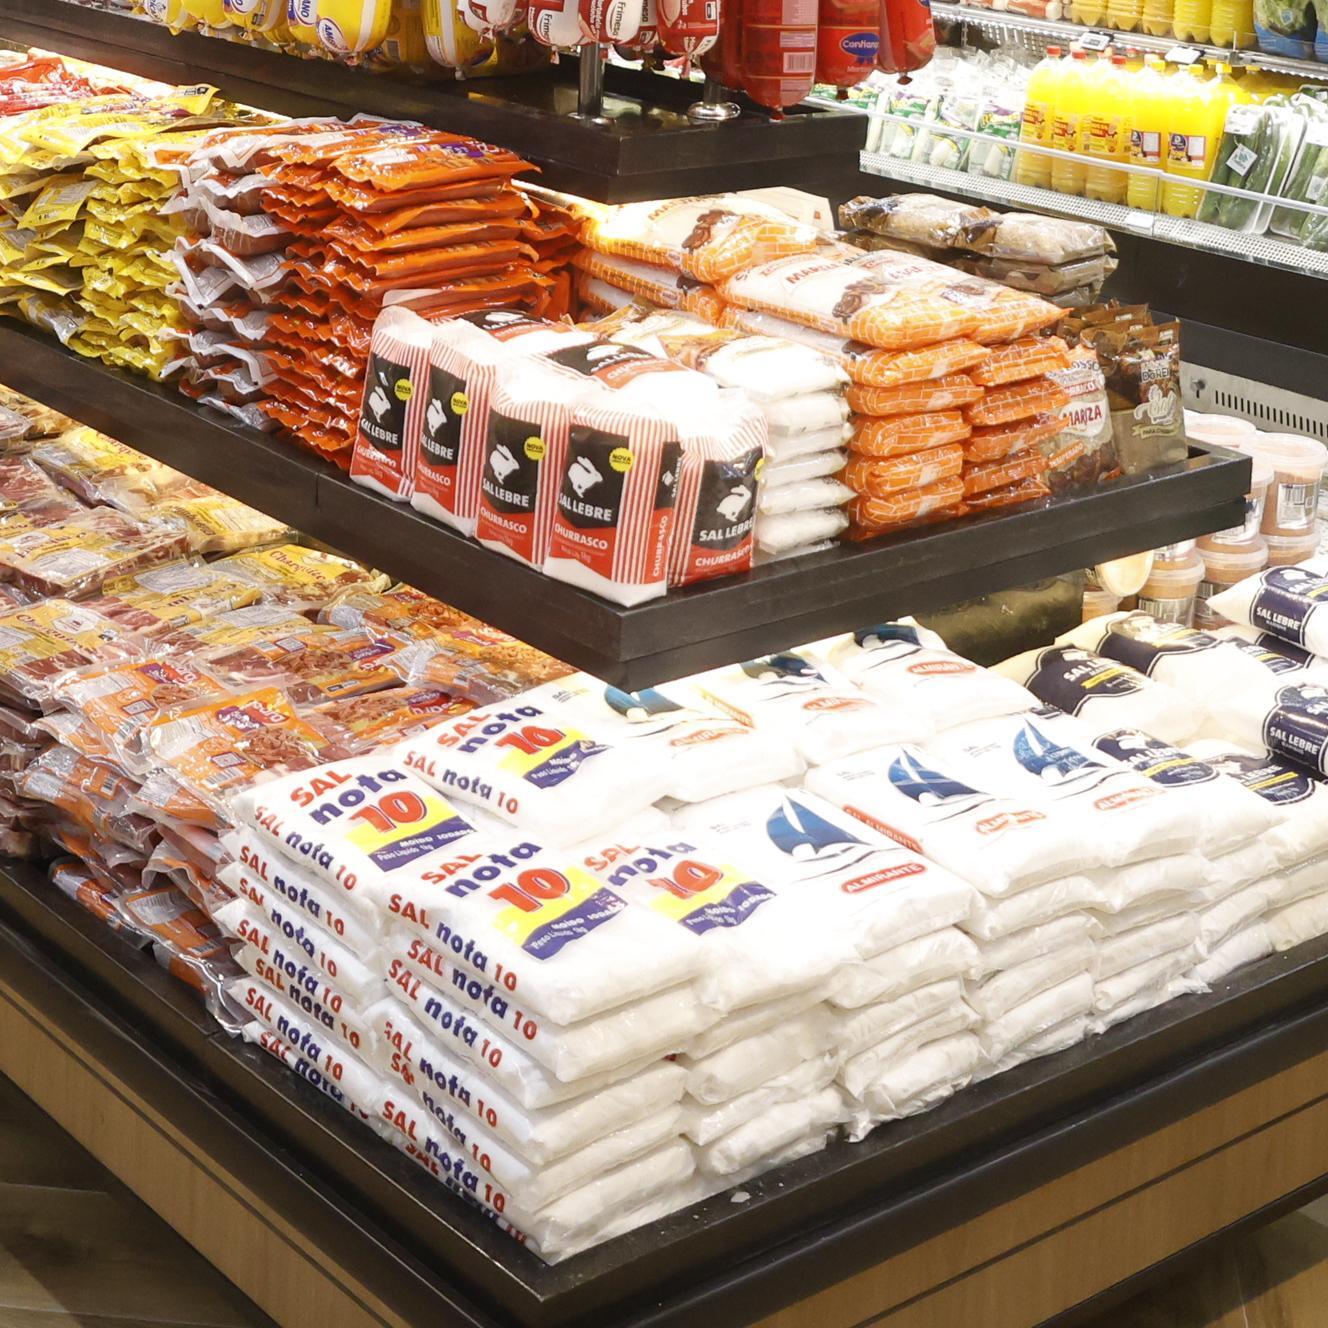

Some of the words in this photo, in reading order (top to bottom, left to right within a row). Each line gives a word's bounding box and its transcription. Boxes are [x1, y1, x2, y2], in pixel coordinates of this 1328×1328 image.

[612, 1, 626, 37] Frimesa
[372, 425, 399, 444] LEBRE
[426, 440, 454, 460] LEBRE
[482, 478, 496, 494] SAL
[495, 486, 529, 507] LEBRE
[559, 492, 573, 513] SAL
[572, 502, 612, 522] LEBRE
[480, 506, 528, 534] CHURRASCO
[555, 523, 608, 550] CHURRASCO
[699, 529, 723, 542] SAL
[1256, 606, 1272, 623] SAL
[1271, 610, 1300, 631] LEBRE
[437, 713, 491, 747] SAL
[457, 705, 544, 753] nota
[1269, 727, 1288, 742] SAL
[1288, 732, 1320, 755] LEBRE
[290, 770, 352, 807] SAL
[309, 769, 408, 825] nota
[403, 751, 436, 777] SAL
[442, 768, 492, 801] nota
[497, 791, 519, 815] 10
[347, 791, 428, 833] 10
[254, 805, 286, 837] SAL
[285, 831, 336, 870] nota
[335, 865, 358, 891] 10
[420, 852, 483, 885] SAL
[583, 842, 642, 873] SAL
[606, 842, 698, 887] nota
[445, 842, 544, 898] nota
[487, 868, 571, 913] 10
[646, 859, 725, 901] 10
[846, 863, 922, 893] ALMIRANTE
[239, 846, 269, 882] SAL
[274, 875, 321, 919] nota
[326, 911, 345, 937] 10
[272, 909, 315, 959] nota
[320, 952, 338, 978] 10
[388, 894, 430, 930] SAL
[436, 922, 489, 972] nota
[495, 964, 517, 992] 10
[237, 919, 269, 955] SAL
[273, 949, 319, 996] nota
[322, 987, 343, 1014] 10
[256, 958, 285, 991] SAL
[289, 984, 335, 1031] nota
[341, 1023, 361, 1050] 10
[407, 939, 444, 977] SAL
[452, 968, 509, 1019] nota
[513, 1010, 538, 1040] 10
[245, 987, 273, 1023] SAL
[277, 1015, 322, 1063] nota
[325, 1055, 343, 1081] 10
[388, 959, 422, 1001] SAL
[424, 997, 479, 1048] nota
[481, 1039, 502, 1069] 10
[419, 1057, 471, 1108] nota
[477, 1099, 498, 1128] 10
[382, 1101, 418, 1142] SAL
[425, 1136, 479, 1193] nota
[485, 1183, 506, 1213] 10
[472, 1143, 492, 1173] 10
